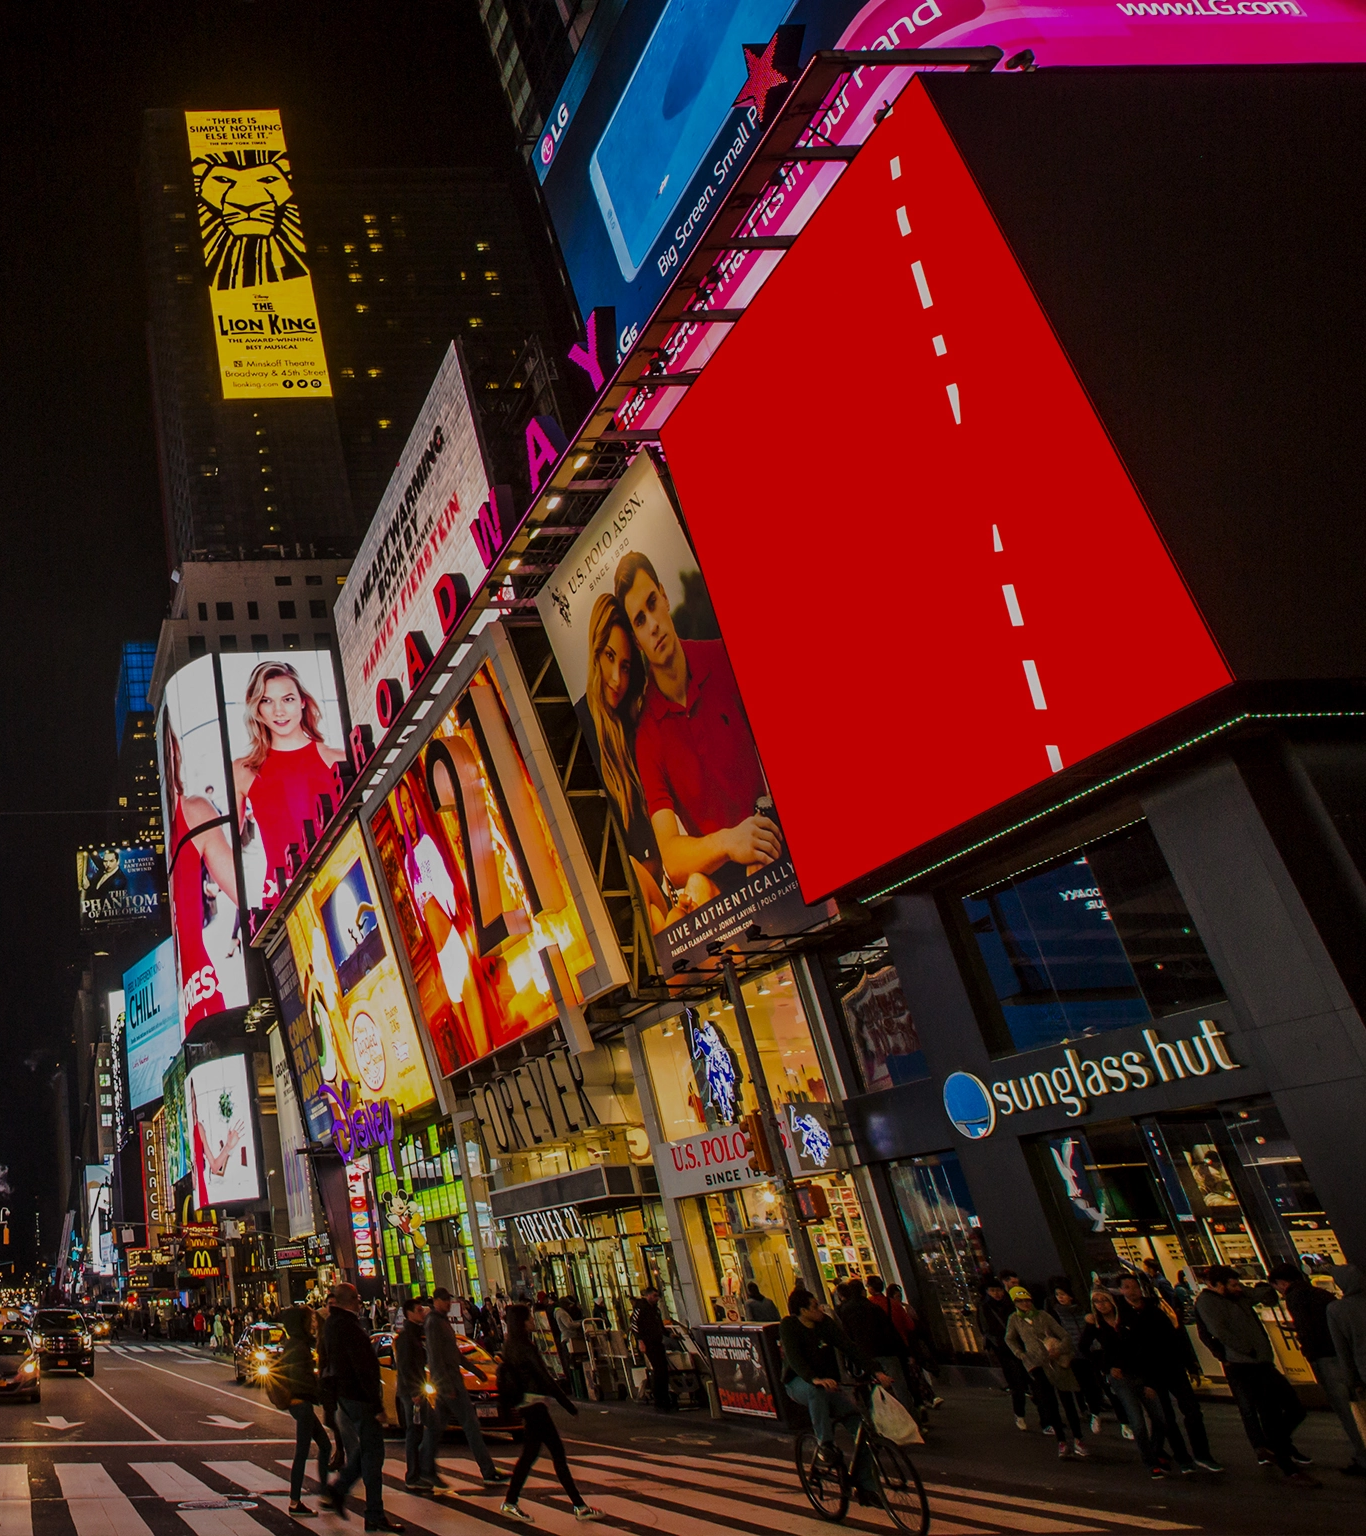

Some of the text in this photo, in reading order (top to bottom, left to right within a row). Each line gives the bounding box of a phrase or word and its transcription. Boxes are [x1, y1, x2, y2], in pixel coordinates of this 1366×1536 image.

[1117, 0, 1300, 17] www.LG.com
[189, 124, 282, 134] SIMPLY NOTHING
[246, 117, 258, 125] IS
[552, 102, 570, 144] LG
[205, 133, 231, 141] ELSE
[231, 132, 254, 140] LIKE
[657, 121, 750, 278] Big Screen. Small
[252, 302, 274, 312] THE
[218, 313, 317, 337] LION KING
[245, 336, 314, 344] AWARD-WINNING
[246, 359, 316, 368] Minskoff Theatre
[225, 369, 327, 380] Broadway & 45th Street
[358, 425, 446, 613] HEARTWARMING
[567, 490, 645, 596] U.S. POLO ASSN.
[588, 537, 630, 592] SINCE 1890
[376, 547, 405, 605] BOOK
[123, 861, 156, 870] FANTASIES
[124, 856, 154, 867] LET YOUR
[127, 866, 152, 874] UNWIND
[82, 893, 159, 913] PHANTOM
[108, 889, 129, 899] THE
[666, 860, 795, 946] LIVE AUTHENTICALLY
[88, 906, 152, 919] OF THE OPERA
[670, 943, 692, 958] PAMELA
[687, 929, 714, 949] FLANAGAN
[717, 915, 737, 931] JONNY
[735, 903, 757, 923] LAVINE
[760, 892, 777, 908] POLO
[129, 982, 161, 1030] CHILL.
[287, 1010, 312, 1049] COME
[992, 1019, 1241, 1118] sunglass hut
[468, 1042, 601, 1166] FOREVER
[670, 1143, 701, 1172] U.S.
[700, 1131, 749, 1167] POLO
[145, 1129, 160, 1221] PALACE
[705, 1168, 741, 1186] SINCE
[513, 1205, 586, 1246] FOREVER 21
[721, 1296, 737, 1305] SALE
[705, 1334, 753, 1349] BROADWAY'S
[709, 1348, 751, 1362] SURE THING
[719, 1387, 776, 1413] CHICAGO
